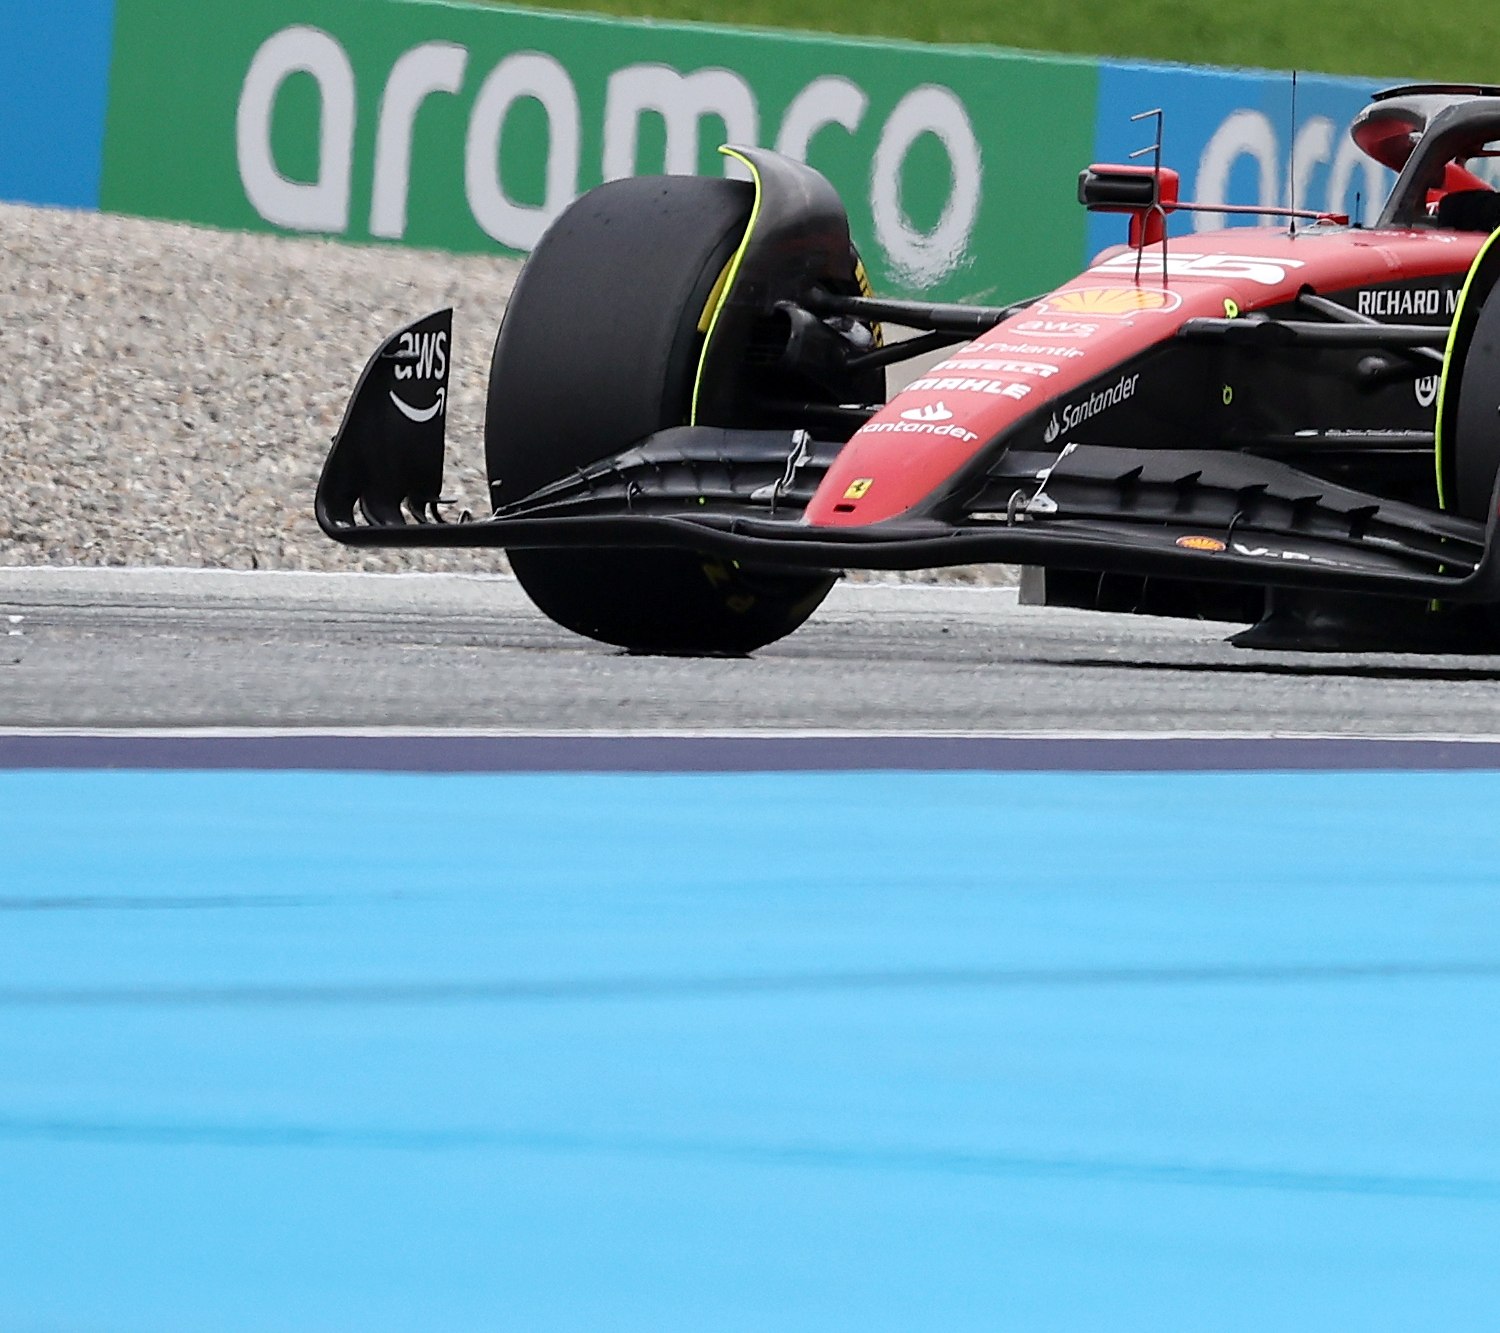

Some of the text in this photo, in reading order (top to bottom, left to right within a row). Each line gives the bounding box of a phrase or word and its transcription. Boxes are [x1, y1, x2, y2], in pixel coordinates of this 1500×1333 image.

[1088, 252, 1306, 285] 55
[1358, 289, 1439, 315] RICHARD
[1017, 319, 1100, 334] aws
[394, 330, 447, 380] aws
[984, 341, 1085, 359] Palantir
[902, 377, 1032, 400] MAHLE
[1061, 373, 1140, 434] Santander
